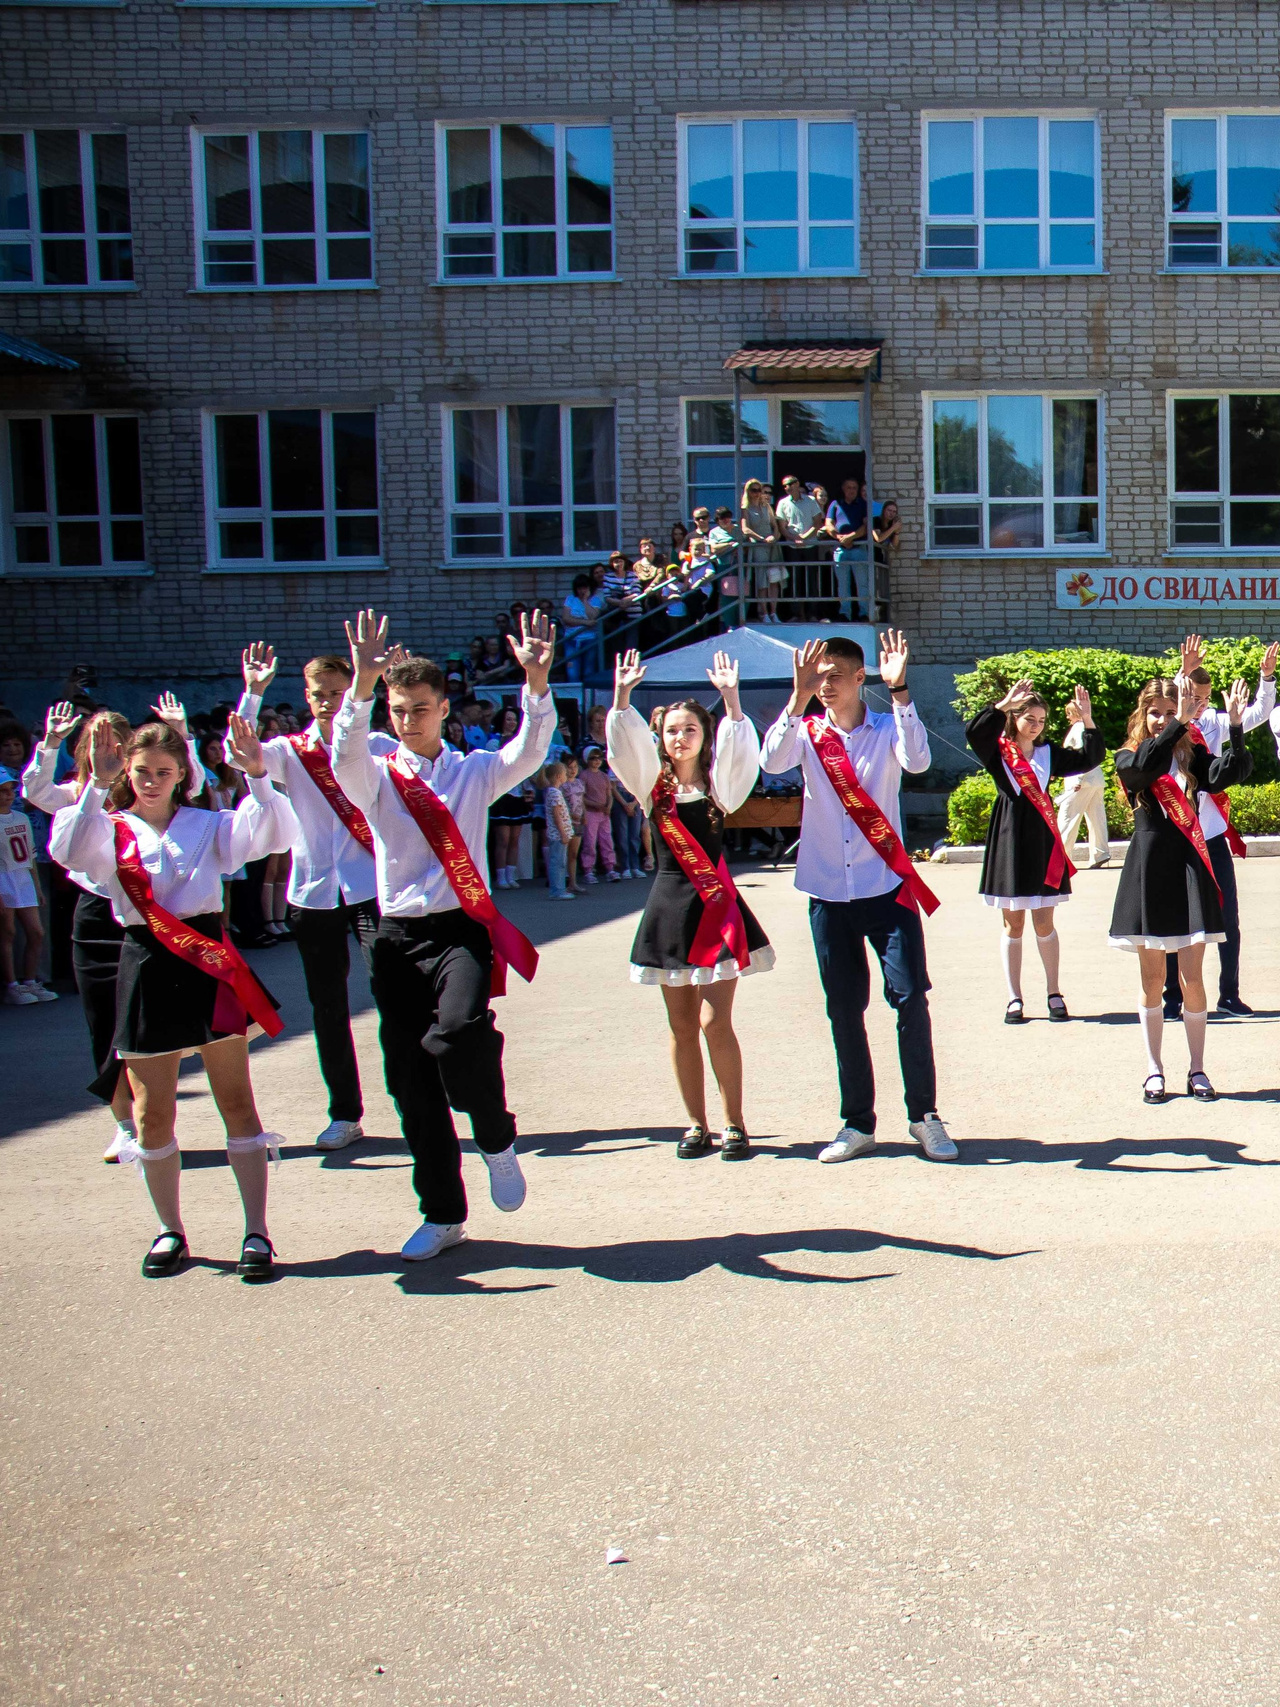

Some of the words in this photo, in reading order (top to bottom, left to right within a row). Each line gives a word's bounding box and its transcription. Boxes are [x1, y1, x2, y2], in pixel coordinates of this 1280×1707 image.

[1100, 577, 1138, 605] ДО
[862, 812, 890, 843] 2025
[449, 854, 480, 888] 2025
